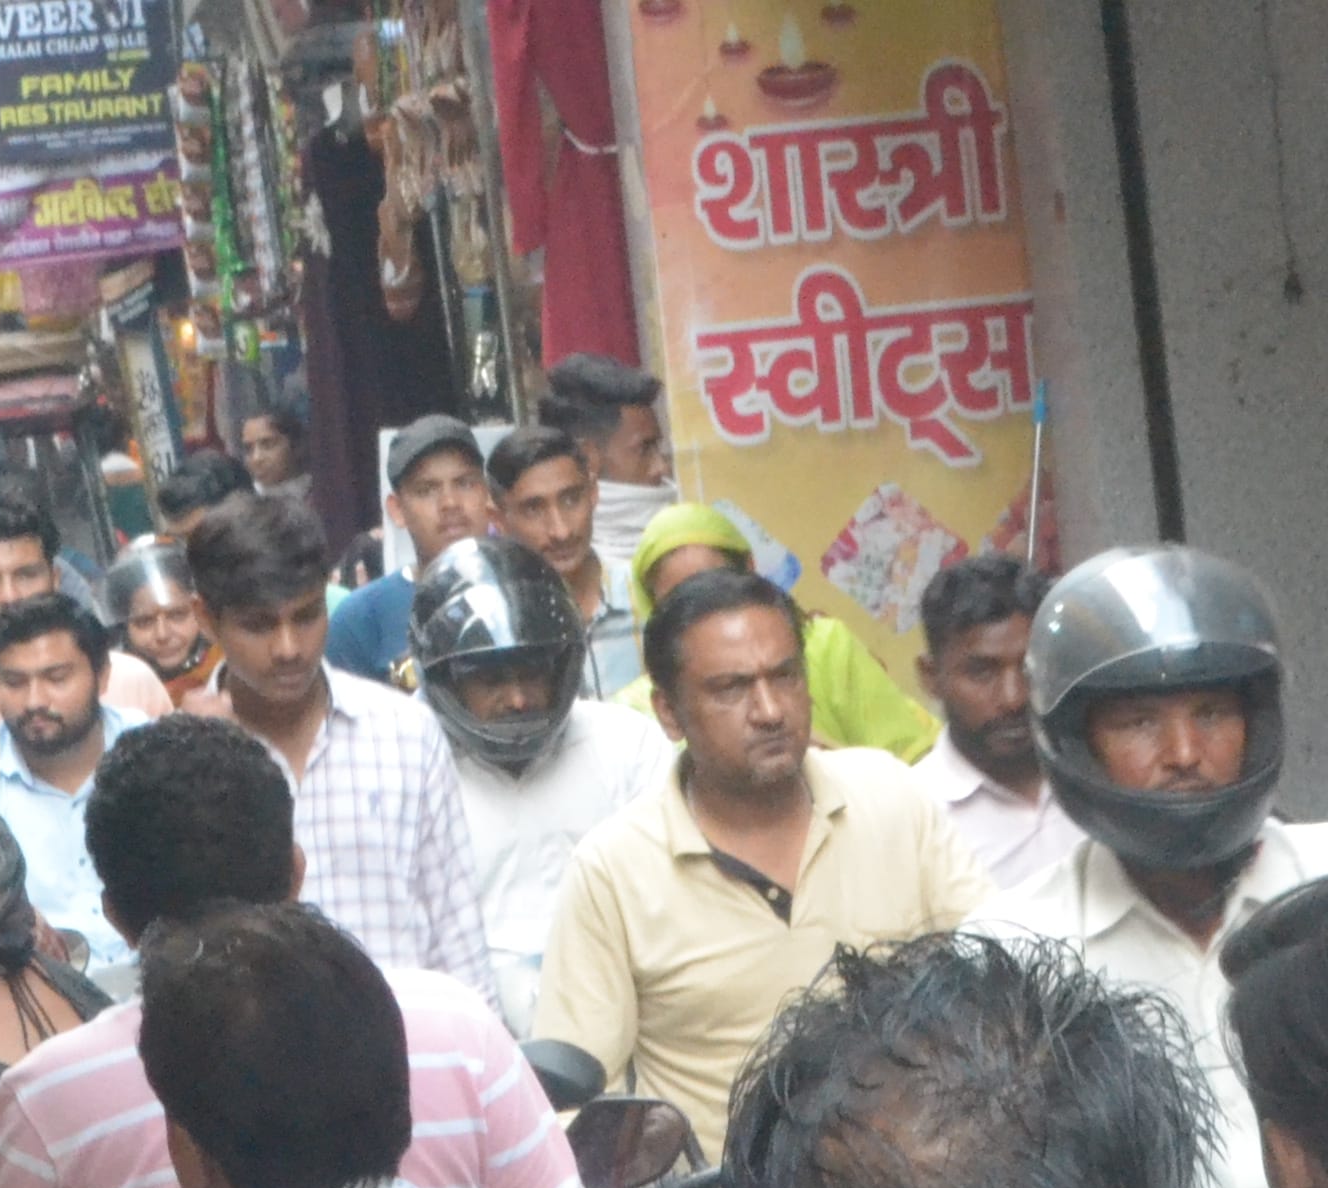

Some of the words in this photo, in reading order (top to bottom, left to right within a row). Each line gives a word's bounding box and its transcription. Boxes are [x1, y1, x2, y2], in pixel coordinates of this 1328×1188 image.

[0, 93, 163, 131] RESTAURANT
[20, 68, 137, 98] FAMILY
[694, 58, 1008, 249] शास्त्री
[694, 264, 1034, 466] स्वीट्स
